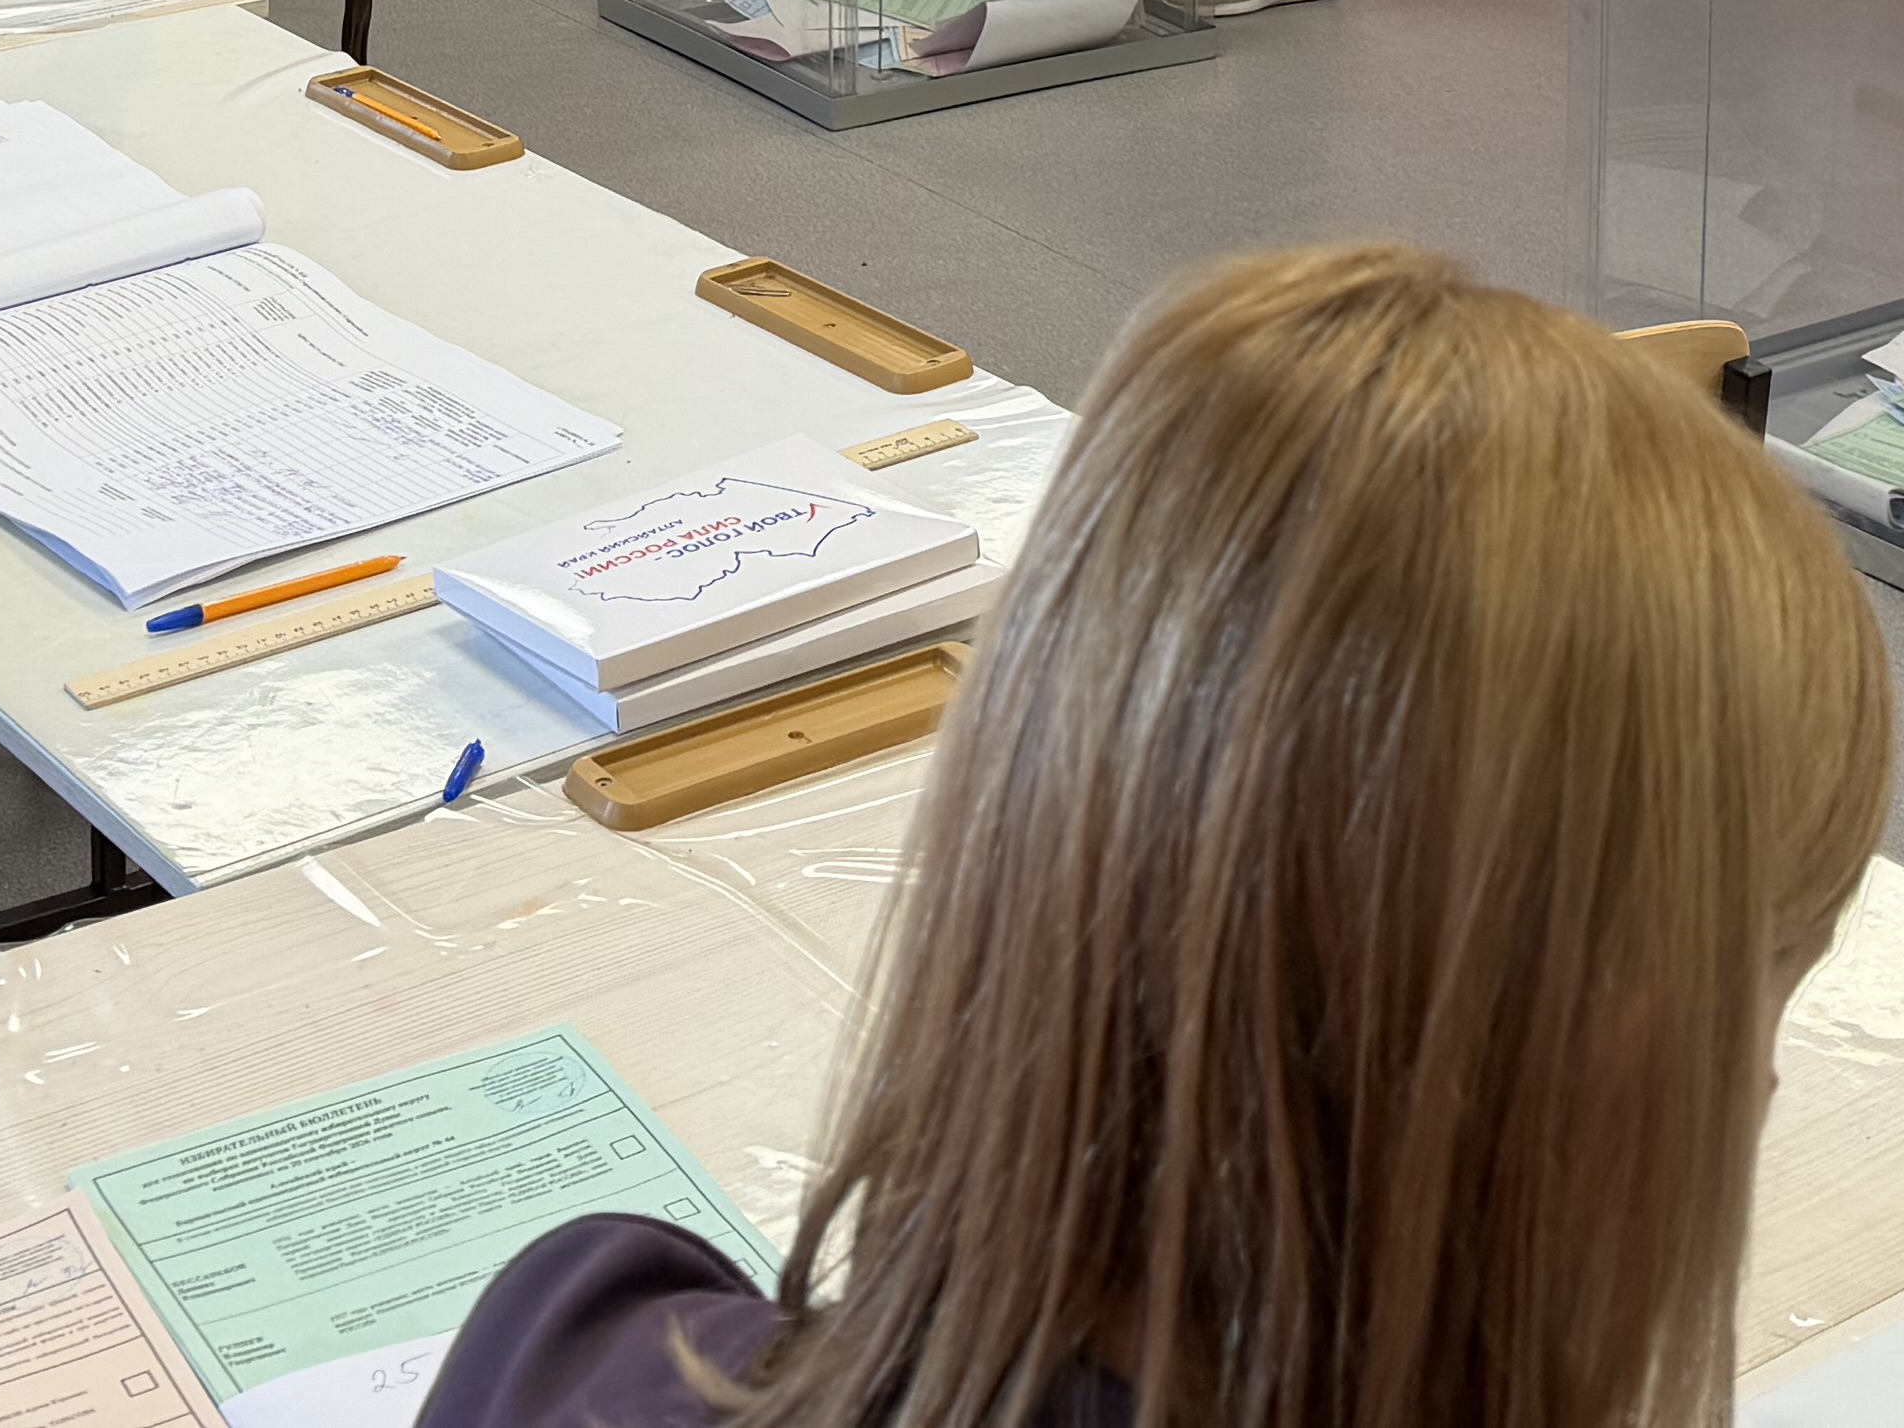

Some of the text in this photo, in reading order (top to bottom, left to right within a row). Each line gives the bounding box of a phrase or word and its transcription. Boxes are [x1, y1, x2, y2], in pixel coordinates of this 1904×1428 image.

[557, 518, 684, 569] АЛТАЙСКИЙ КРАЙ
[666, 526, 744, 559] ГОЛОС
[744, 507, 808, 534] ТВОЙ
[576, 516, 742, 579] СИЛА РОССИИ!
[179, 1097, 383, 1166] ИЗБИРАТЕЛЬНЫЙ БЮЛЛЕТЕНЬ
[371, 1351, 433, 1393] 25
